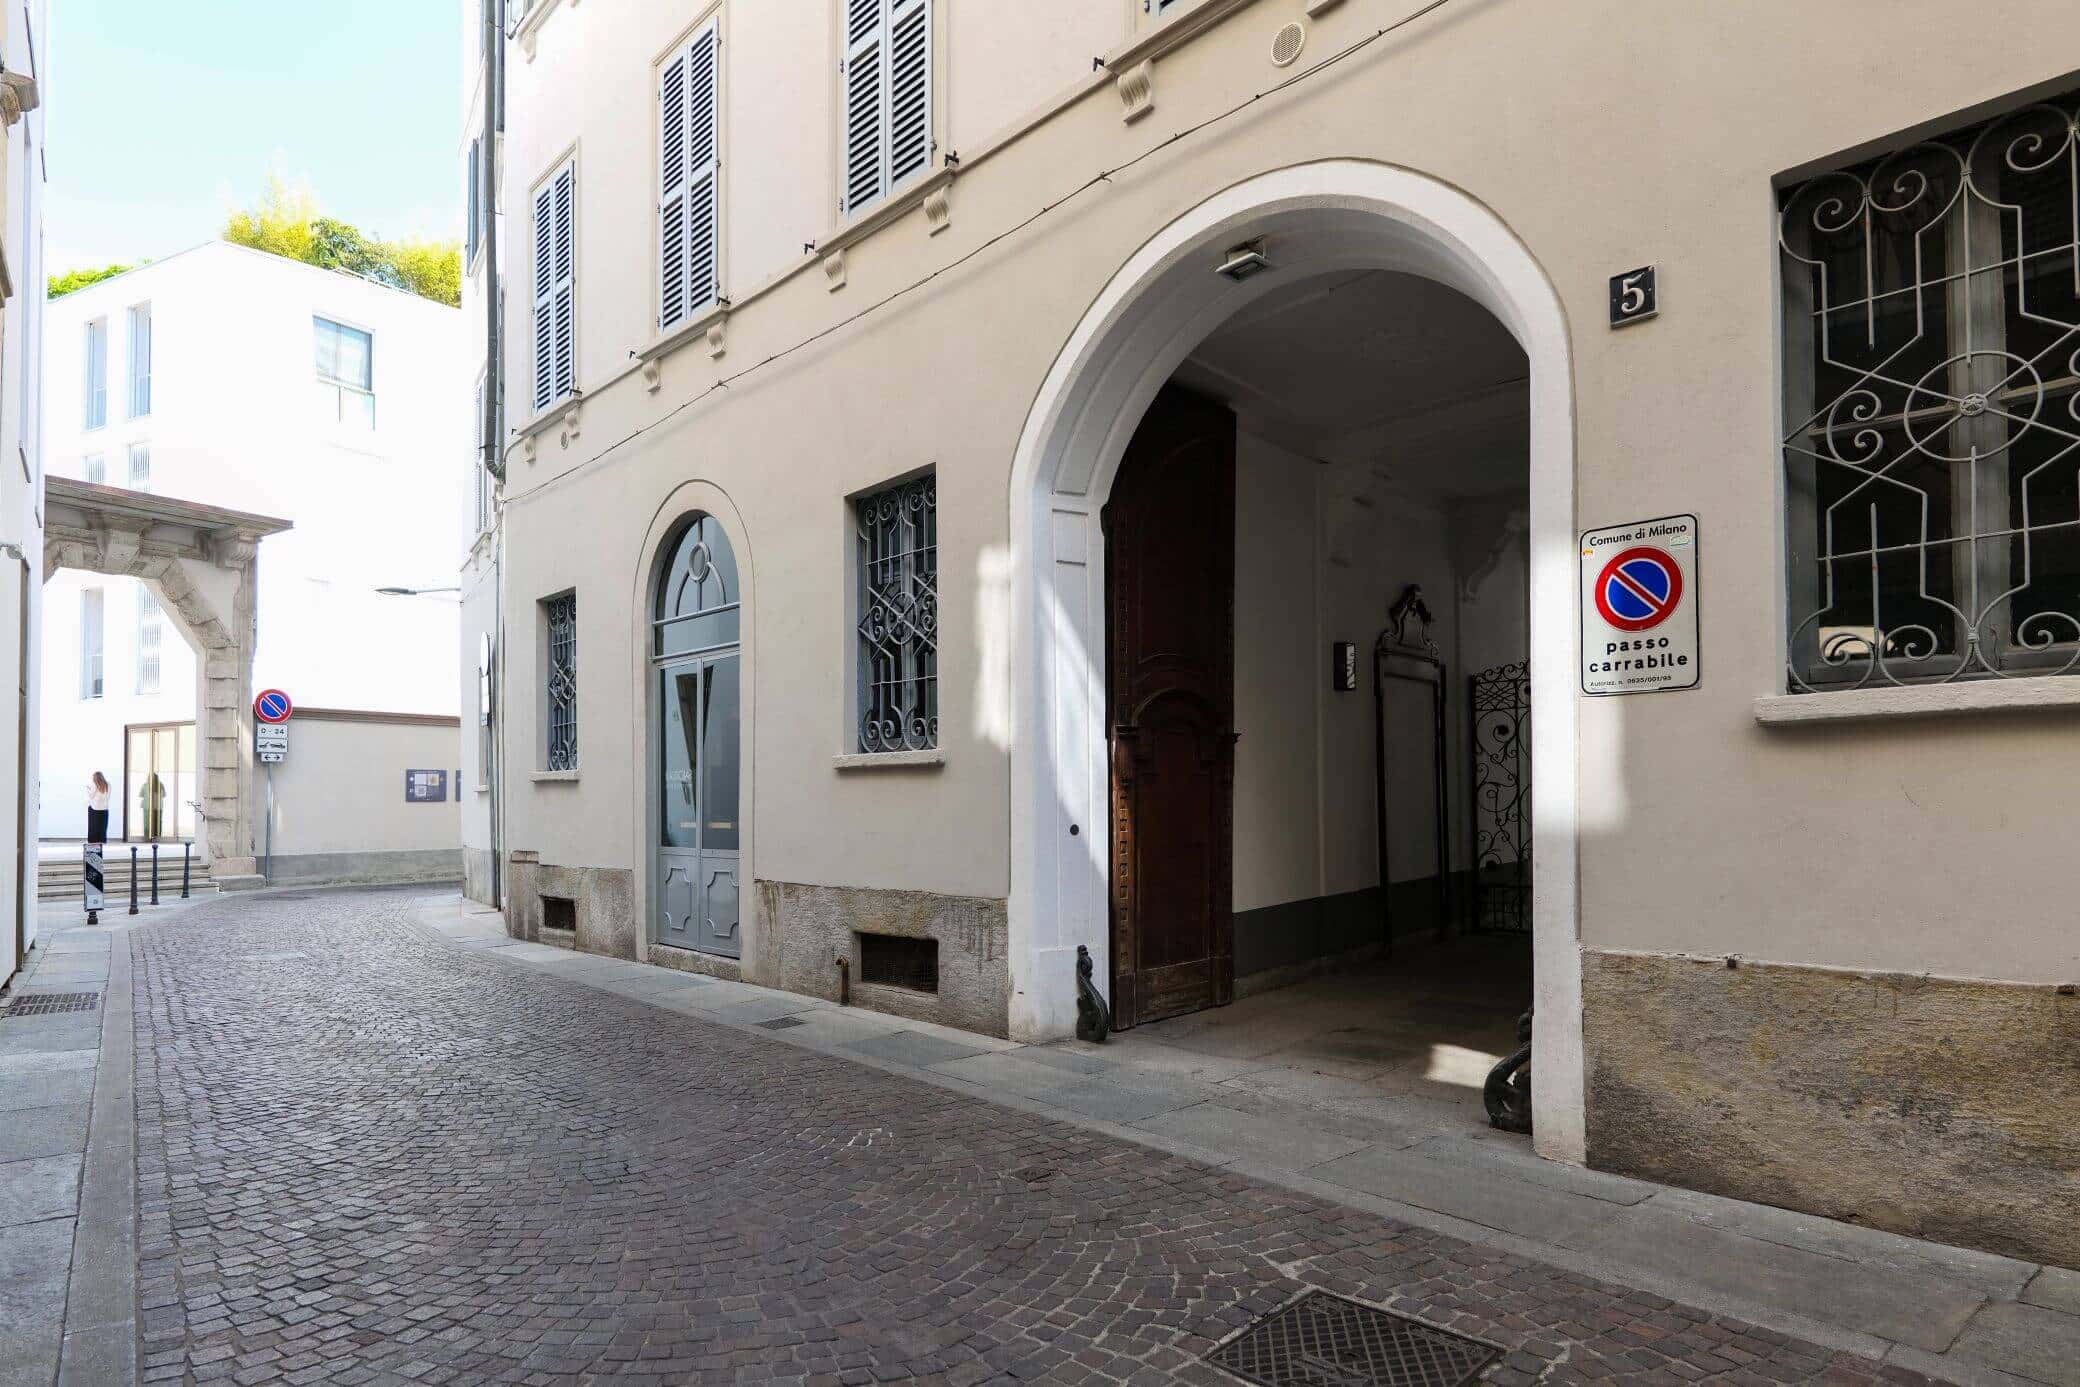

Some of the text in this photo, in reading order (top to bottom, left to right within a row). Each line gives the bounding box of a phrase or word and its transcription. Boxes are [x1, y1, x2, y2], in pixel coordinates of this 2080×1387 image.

[1621, 272, 1645, 314] 5
[1590, 524, 1687, 546] Comune di Milano
[1606, 637, 1669, 655] passo
[1589, 653, 1688, 672] carrabile
